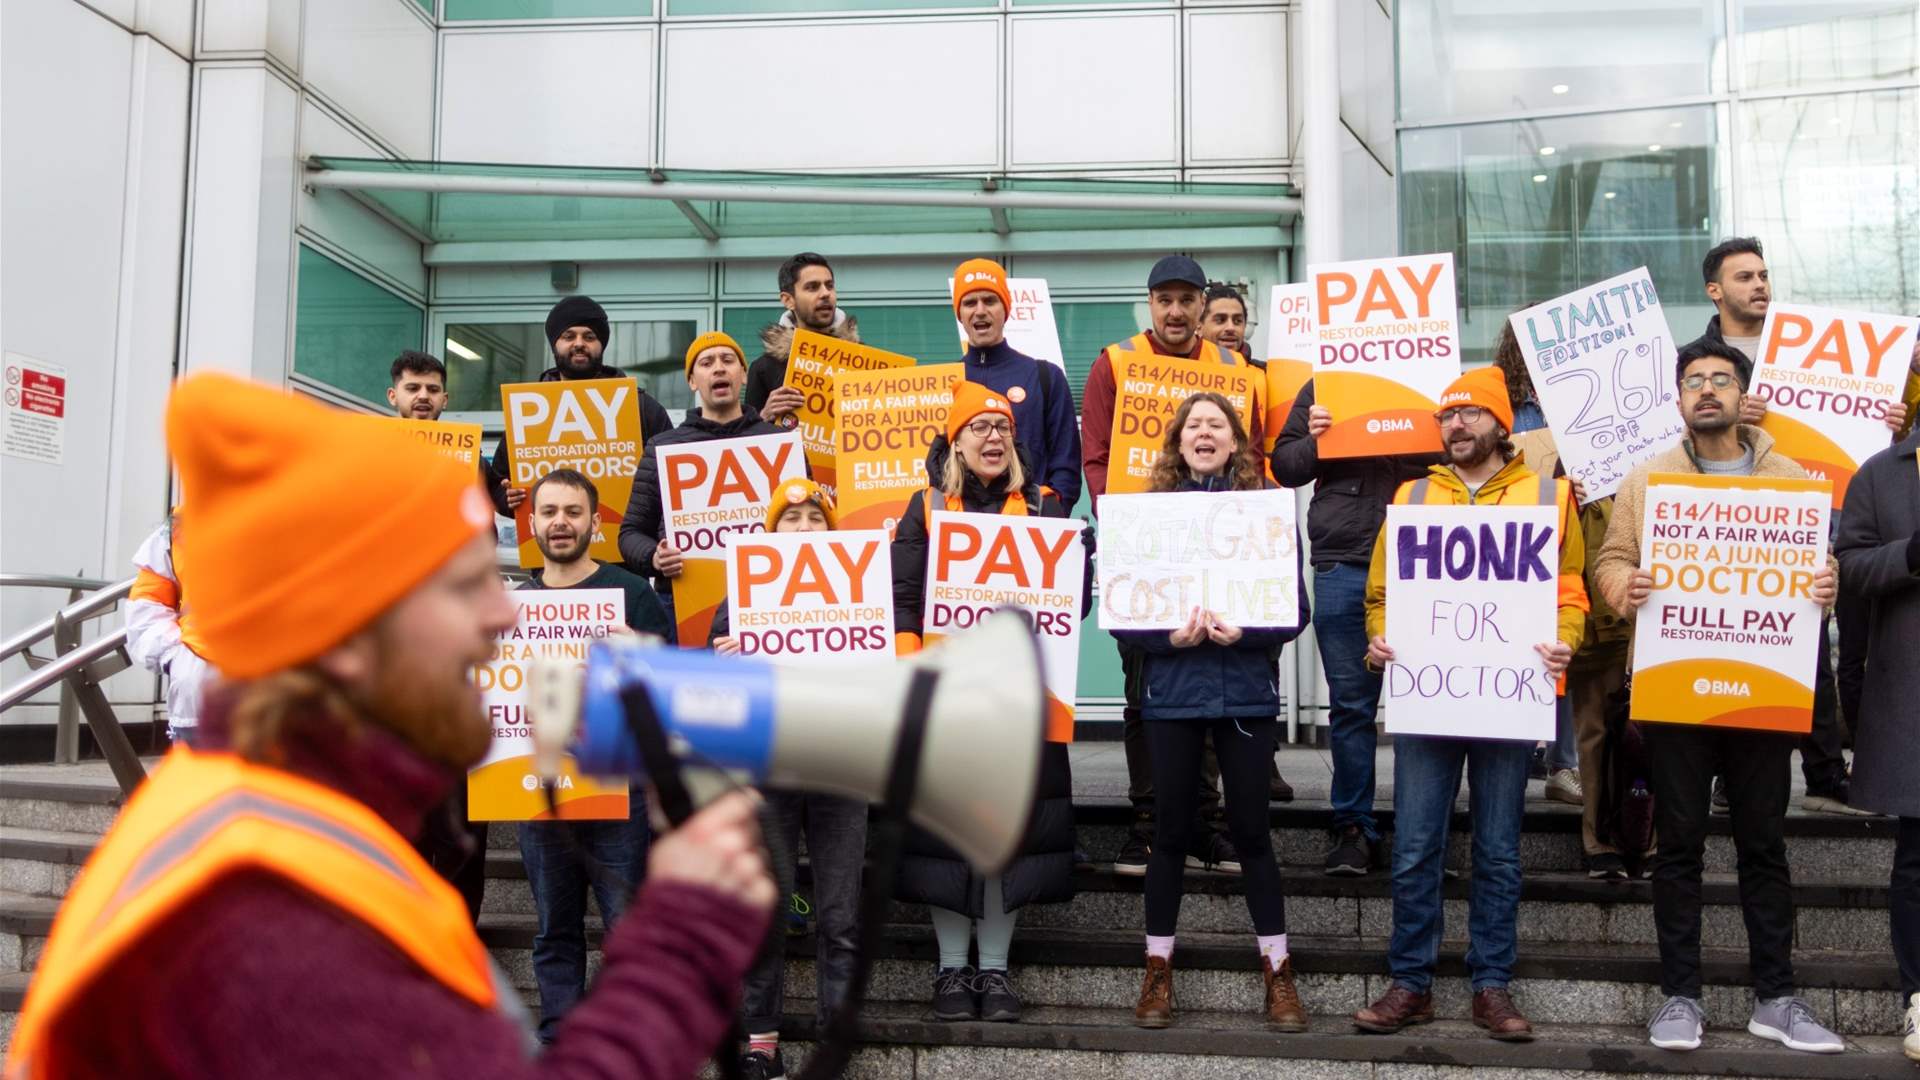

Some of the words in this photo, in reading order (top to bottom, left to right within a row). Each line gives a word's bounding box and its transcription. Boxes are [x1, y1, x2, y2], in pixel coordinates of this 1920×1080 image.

[1316, 264, 1444, 325] PAY
[1527, 278, 1657, 350] LIMITED
[1320, 322, 1417, 340] RESTORATION
[1421, 320, 1450, 332] FOR
[799, 342, 888, 370] £14/HOUR
[1320, 336, 1451, 365] DOCTORS
[1537, 323, 1635, 371] EDITION!
[1764, 312, 1908, 378] PAY
[795, 358, 823, 373] NOT
[824, 366, 833, 376] A
[1128, 363, 1226, 390] £14/HOUR
[1230, 378, 1247, 392] IS
[792, 372, 825, 390] FOR
[842, 377, 936, 397] £14/HOUR
[942, 375, 958, 390] IS
[1124, 381, 1154, 394] NOT
[1157, 385, 1168, 396] A
[1760, 368, 1862, 392] RESTORATION
[1864, 382, 1895, 396] FOR
[840, 399, 870, 412] NOT
[873, 398, 882, 410] A
[886, 394, 916, 408] FAIR
[1123, 396, 1159, 412] FOR
[1163, 402, 1175, 415] A
[1756, 382, 1890, 421] DOCTORS
[509, 387, 629, 444] PAY
[842, 413, 876, 428] FOR
[881, 412, 892, 426] A
[896, 407, 952, 426] JUNIO
[1382, 418, 1413, 432] BMA
[458, 434, 474, 448] IS
[843, 424, 948, 452] DOCTO
[1592, 420, 1640, 449] OFF
[516, 444, 606, 458] RESTORATION
[610, 442, 636, 453] FOR
[1600, 452, 1622, 472] your
[1627, 438, 1654, 454] Doctor
[665, 442, 794, 511] PAY
[854, 460, 908, 480] FULL
[854, 478, 925, 490] RESTORATION
[672, 506, 768, 527] RESTORATION
[1655, 501, 1789, 524] £14/HOUR
[1796, 508, 1820, 526] IS
[1653, 524, 1693, 540] NOT
[1696, 526, 1710, 540] A
[1716, 527, 1757, 542] FAIR
[1763, 529, 1818, 546] WAGE
[936, 522, 1078, 589] PAY
[1398, 522, 1554, 582] HONK
[1651, 542, 1700, 561] FOR
[1704, 545, 1720, 562] A
[1726, 546, 1817, 567] JUNIOR
[736, 541, 880, 608] PAY
[1650, 563, 1814, 599] DOCTOR
[934, 586, 1040, 606] RESTORATION
[1044, 594, 1074, 608] FOR
[596, 603, 616, 620] IS
[738, 608, 850, 626] RESTORATION
[854, 608, 885, 621] FOR
[1432, 600, 1509, 642] FOR
[1662, 605, 1734, 630] FULL
[1743, 610, 1796, 632] PAY
[512, 626, 524, 640] A
[528, 626, 564, 640] FAIR
[740, 626, 886, 656] DOCTORS
[1660, 628, 1756, 644] RESTORATION
[1760, 634, 1794, 646] NOW
[521, 644, 536, 660] A
[1390, 663, 1555, 706] DOCTORS
[1712, 681, 1750, 696] BMA
